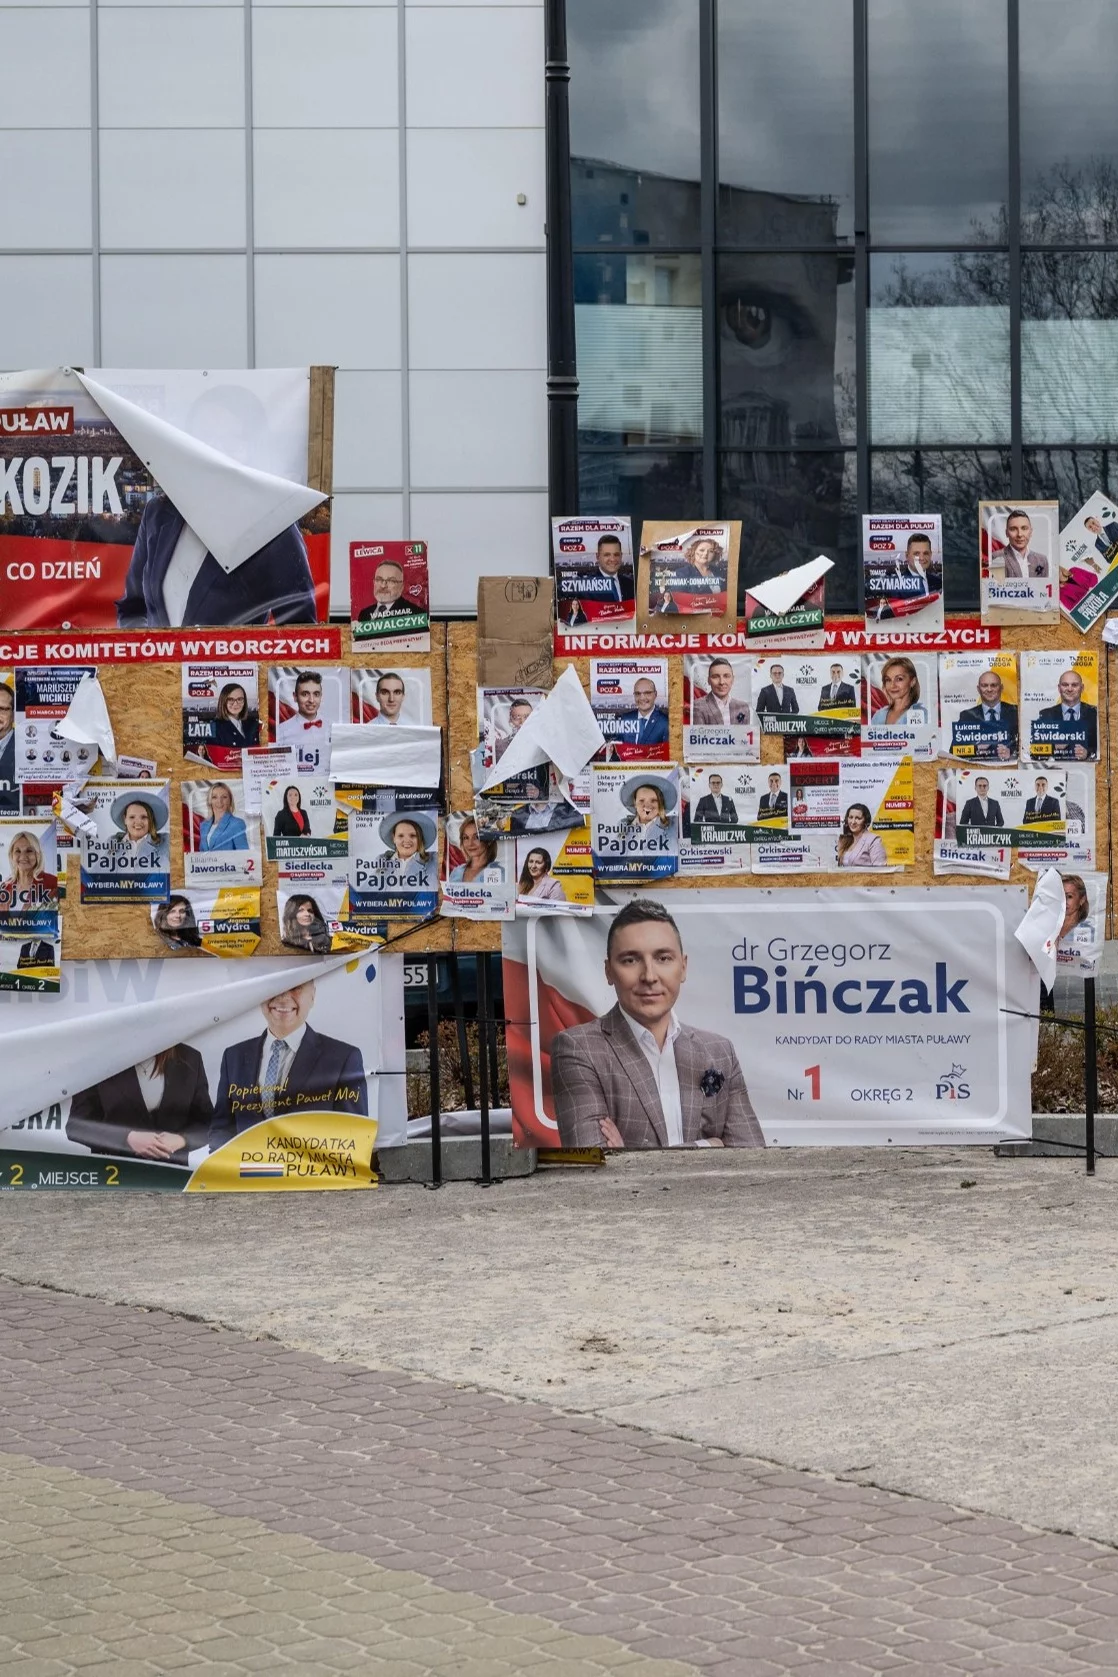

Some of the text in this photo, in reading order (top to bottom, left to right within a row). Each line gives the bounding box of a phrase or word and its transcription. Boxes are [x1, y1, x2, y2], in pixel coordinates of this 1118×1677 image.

[0, 457, 123, 515] KOZIK
[356, 545, 422, 556] LEWICA 11
[7, 557, 101, 580] CO DZIEŃ
[562, 578, 612, 592] SZYMAŃSKI
[870, 576, 919, 590] SZYMAŃSKI
[356, 617, 425, 633] KOWALCZYK
[751, 612, 819, 630] KOWALCZYK
[565, 634, 701, 650] INFORMACJE
[842, 629, 989, 646] WYBORCZYCH
[46, 639, 175, 659] KOMITETÓW
[181, 638, 329, 656] WYBORCZYCH
[188, 724, 212, 737] ŁATA
[764, 721, 806, 732] KRAWCZYK
[690, 735, 735, 745] Bińczak
[868, 731, 915, 740] Siedlecka
[956, 731, 1007, 742] Świderski
[1034, 731, 1085, 741] Świderski
[399, 792, 432, 800] skuteczny
[598, 824, 641, 833] Paulina
[701, 831, 746, 841] KRAWCZYK
[967, 834, 1012, 844] KRAWCZYK
[87, 840, 132, 850] Paulina
[276, 844, 327, 857] MATUSZYŃSKA
[598, 835, 670, 855] Pajórek
[758, 845, 810, 854] Orkiszewski
[680, 848, 732, 857] Orkiszewski
[940, 848, 985, 861] Bińczak
[87, 852, 161, 872] Pajórek
[191, 864, 236, 873] Jaworska
[285, 862, 333, 871] Siedlecka
[356, 859, 401, 869] Paulina
[356, 871, 430, 890] Pajórek
[446, 888, 492, 898] Siedlecka
[216, 922, 250, 932] Wydra
[732, 938, 891, 967] dr Grzegorz
[404, 967, 428, 984] 55
[733, 962, 970, 1014] Bińczak
[776, 1034, 971, 1045] KANDYDAT DO RADY MIASTA PUŁAWY
[229, 1078, 288, 1099] Popieram!
[788, 1064, 970, 1104] Nr 1 OKRĘG 2 PiS
[232, 1087, 360, 1114] Prezydent Paweł Maj
[267, 1137, 356, 1150] KANDYDATKA
[242, 1152, 353, 1164] DO RADY MIASTA
[10, 1164, 119, 1185] 2 MIEJSCE 2
[287, 1164, 356, 1176] PUŁAWY
